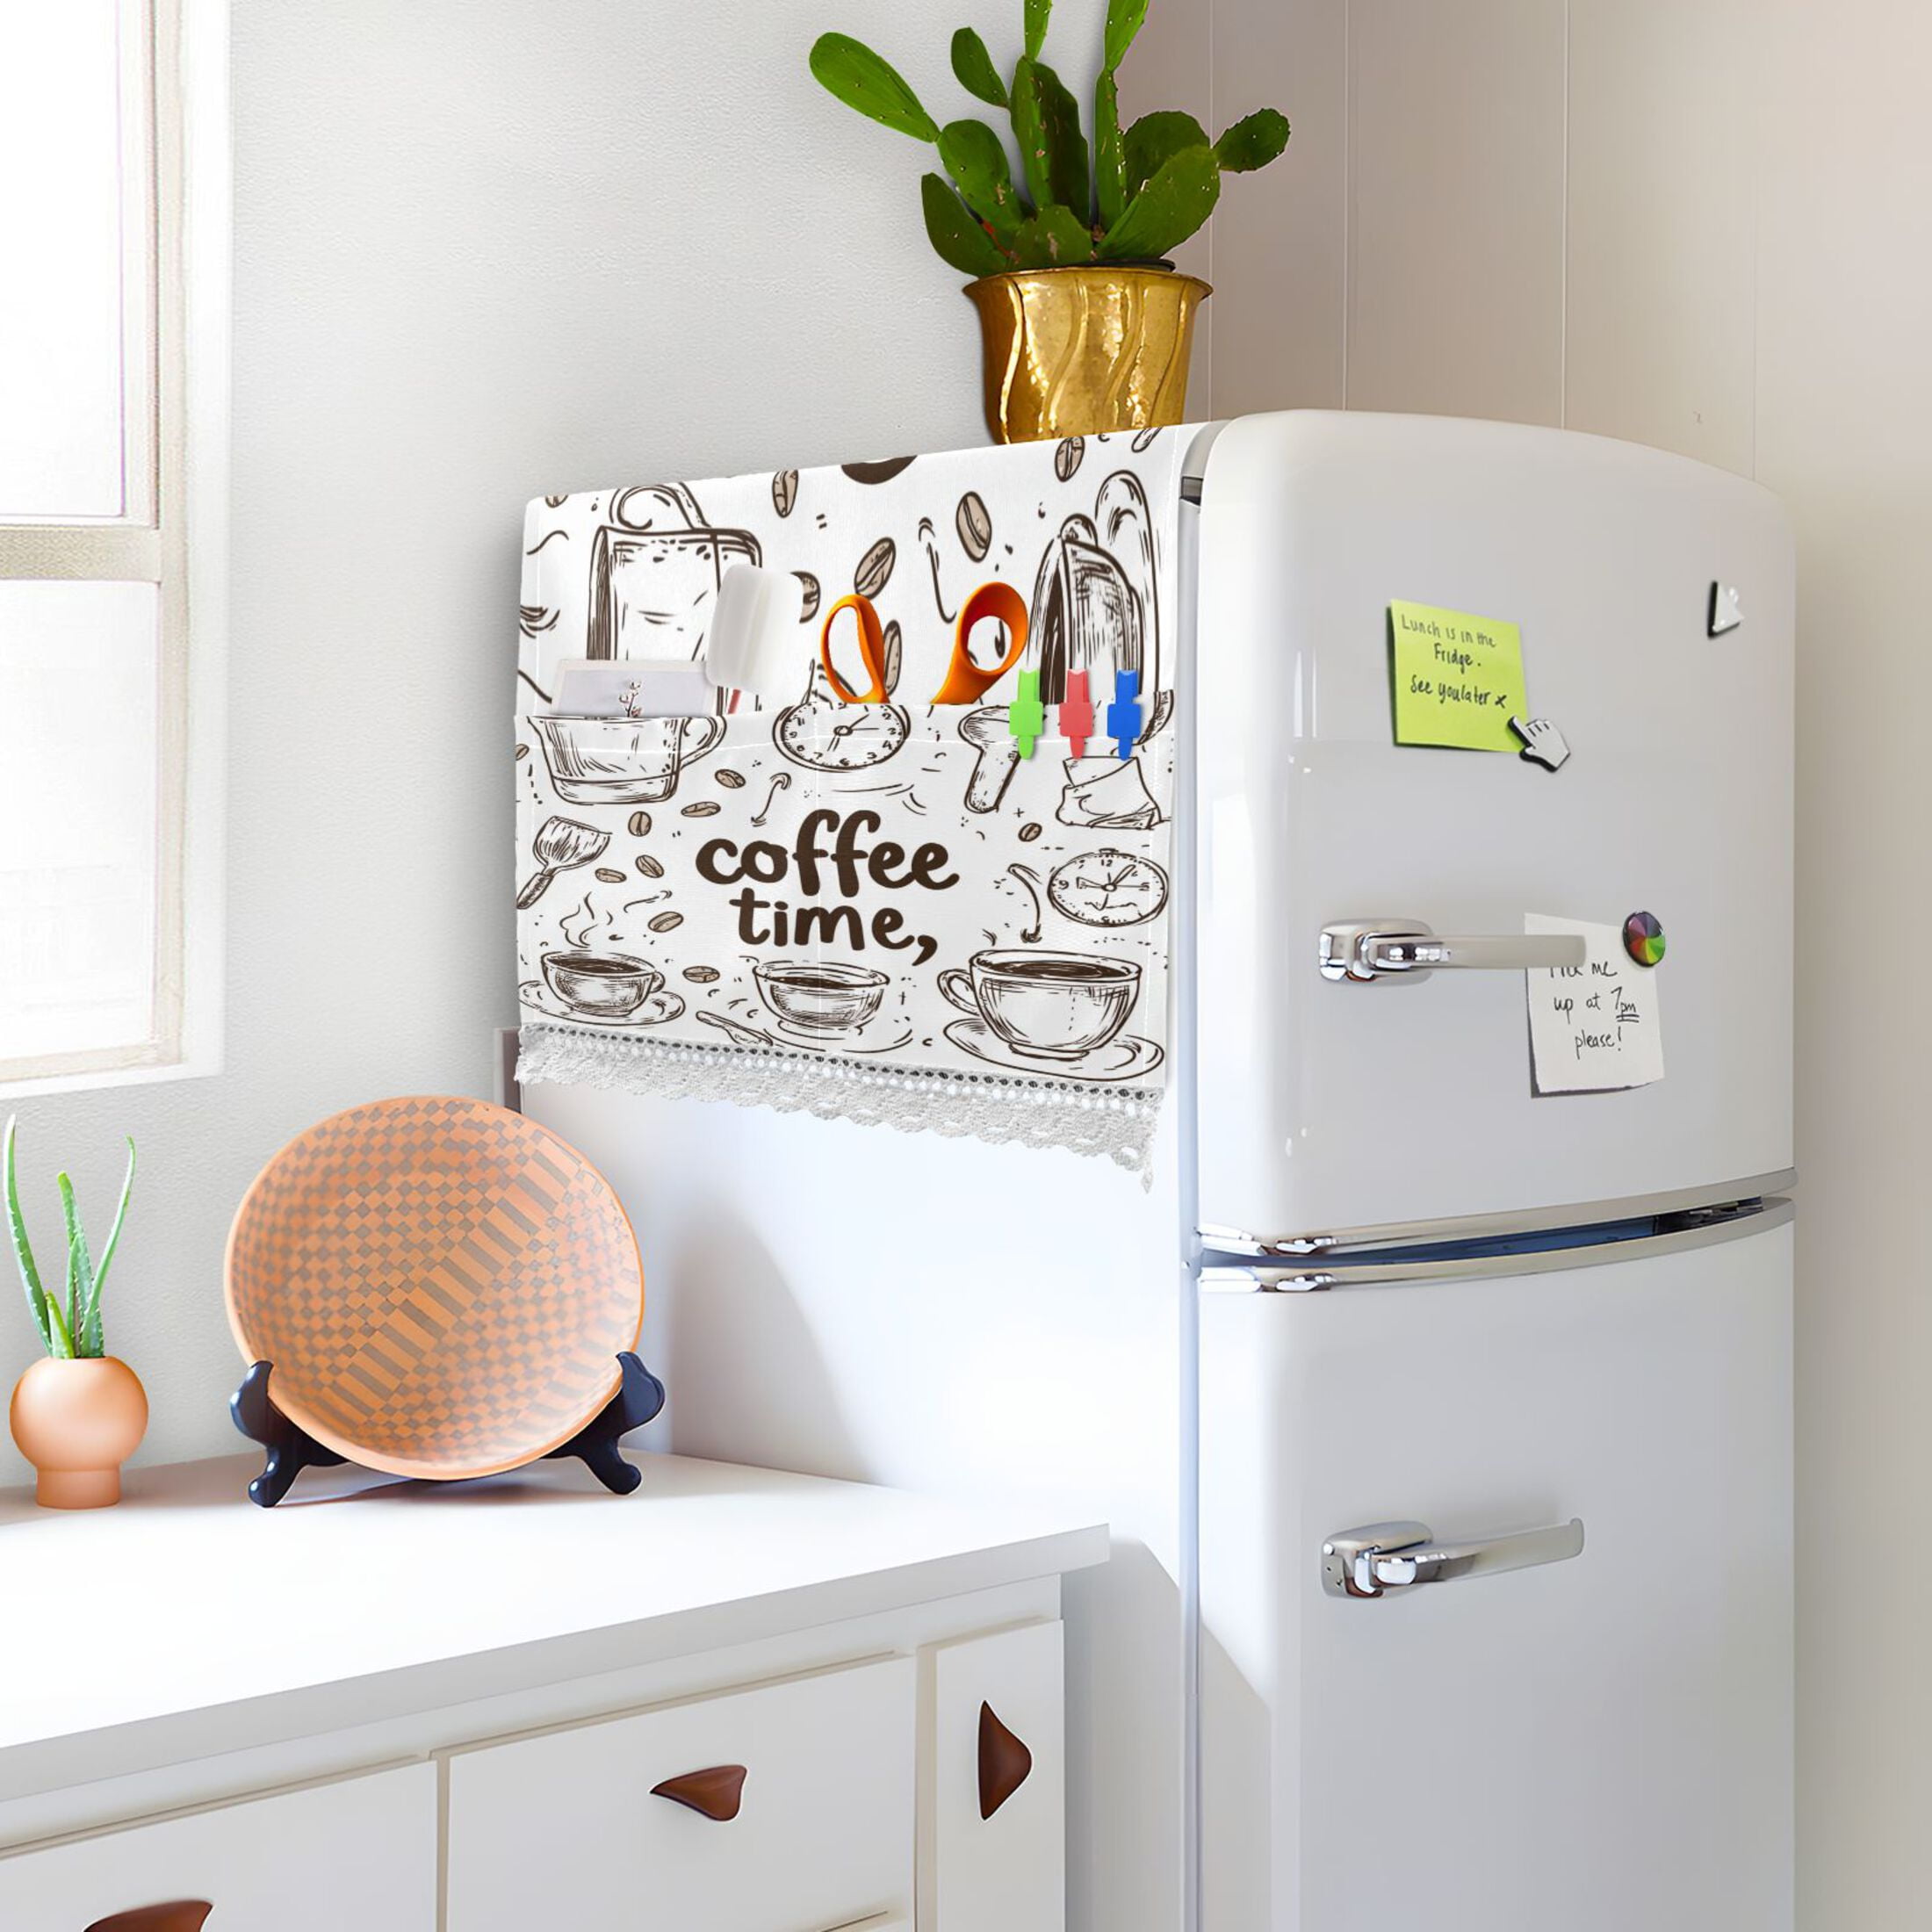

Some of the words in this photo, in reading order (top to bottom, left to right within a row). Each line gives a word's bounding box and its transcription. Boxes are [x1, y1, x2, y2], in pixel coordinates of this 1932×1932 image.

[1402, 614, 1440, 639] Lunch
[1461, 631, 1474, 644] in
[1477, 631, 1496, 648] the
[1410, 674, 1433, 694] See
[696, 809, 960, 898] coffee
[729, 887, 938, 966] time,
[1554, 997, 1574, 1024] up
[1586, 992, 1601, 1010] at
[1575, 1026, 1622, 1060] please!
